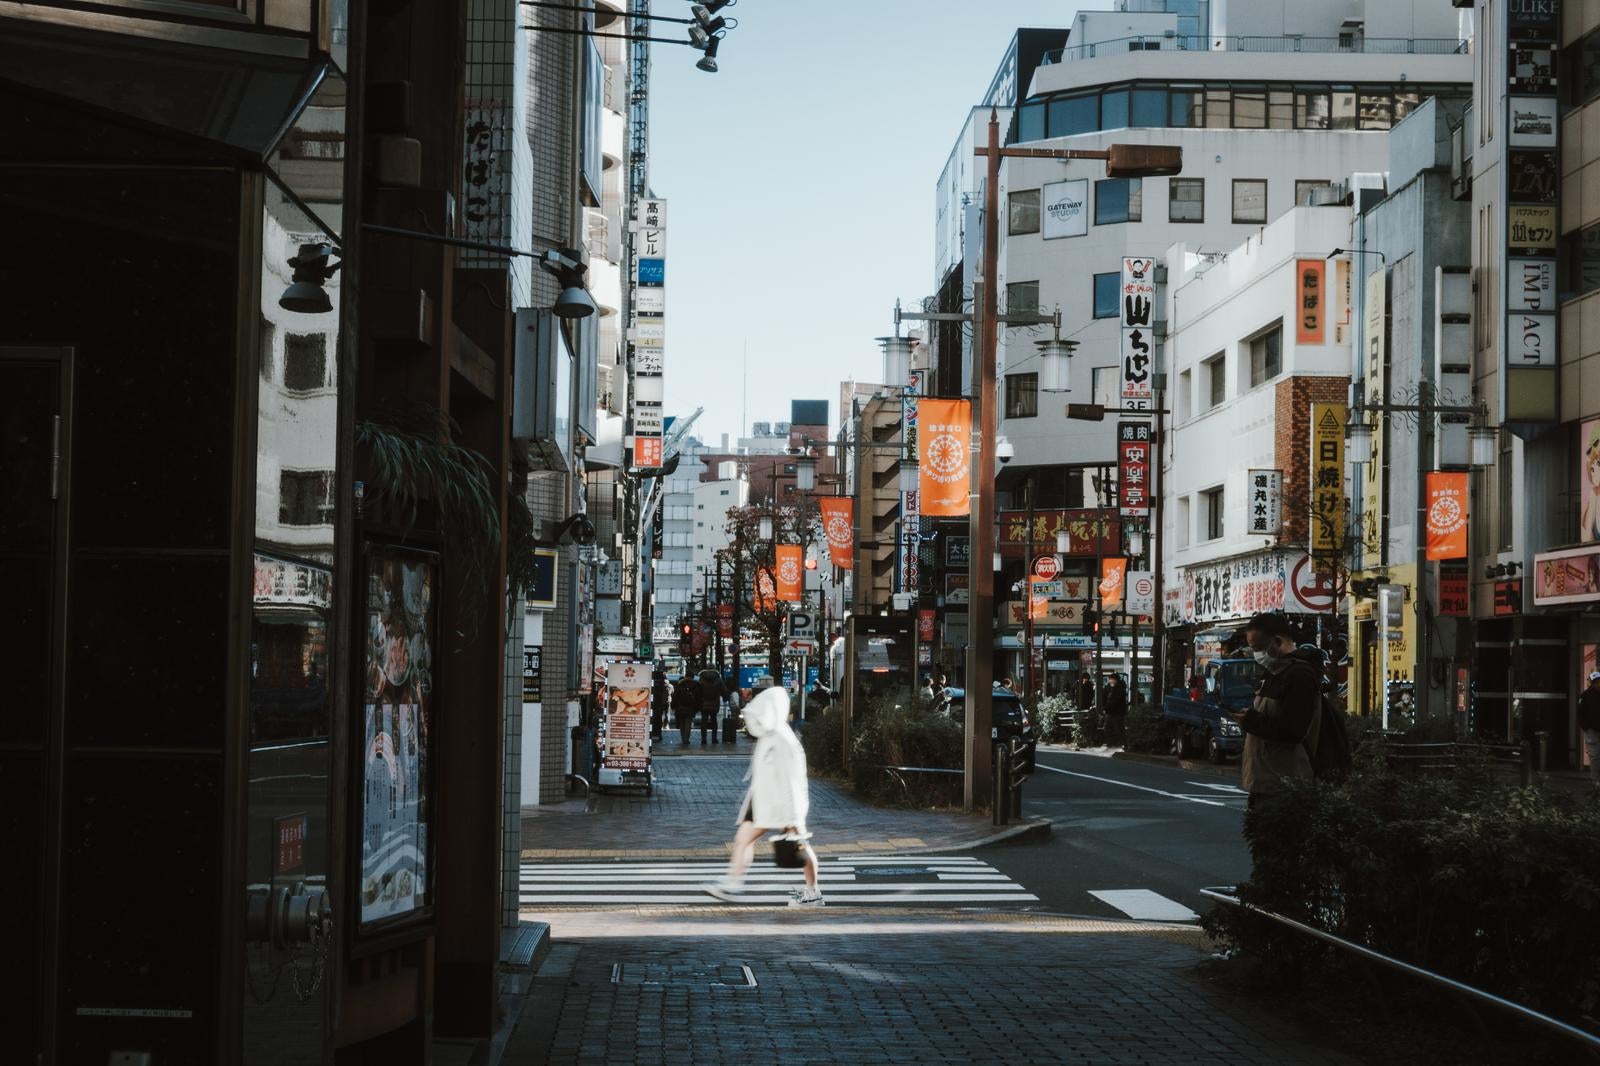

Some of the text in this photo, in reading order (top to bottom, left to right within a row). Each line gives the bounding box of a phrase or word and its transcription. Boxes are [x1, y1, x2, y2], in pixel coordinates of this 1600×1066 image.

[1047, 201, 1083, 212] GATEWAY
[1050, 208, 1080, 218] STUDIO
[1541, 263, 1549, 290] CLUB
[1123, 426, 1148, 440] 焼肉
[1125, 446, 1145, 505] 安楽亭
[1318, 441, 1340, 513] 日焼け
[1254, 474, 1268, 531] 磯丸水産
[790, 613, 811, 636] P
[1057, 637, 1085, 645] FamilyMart
